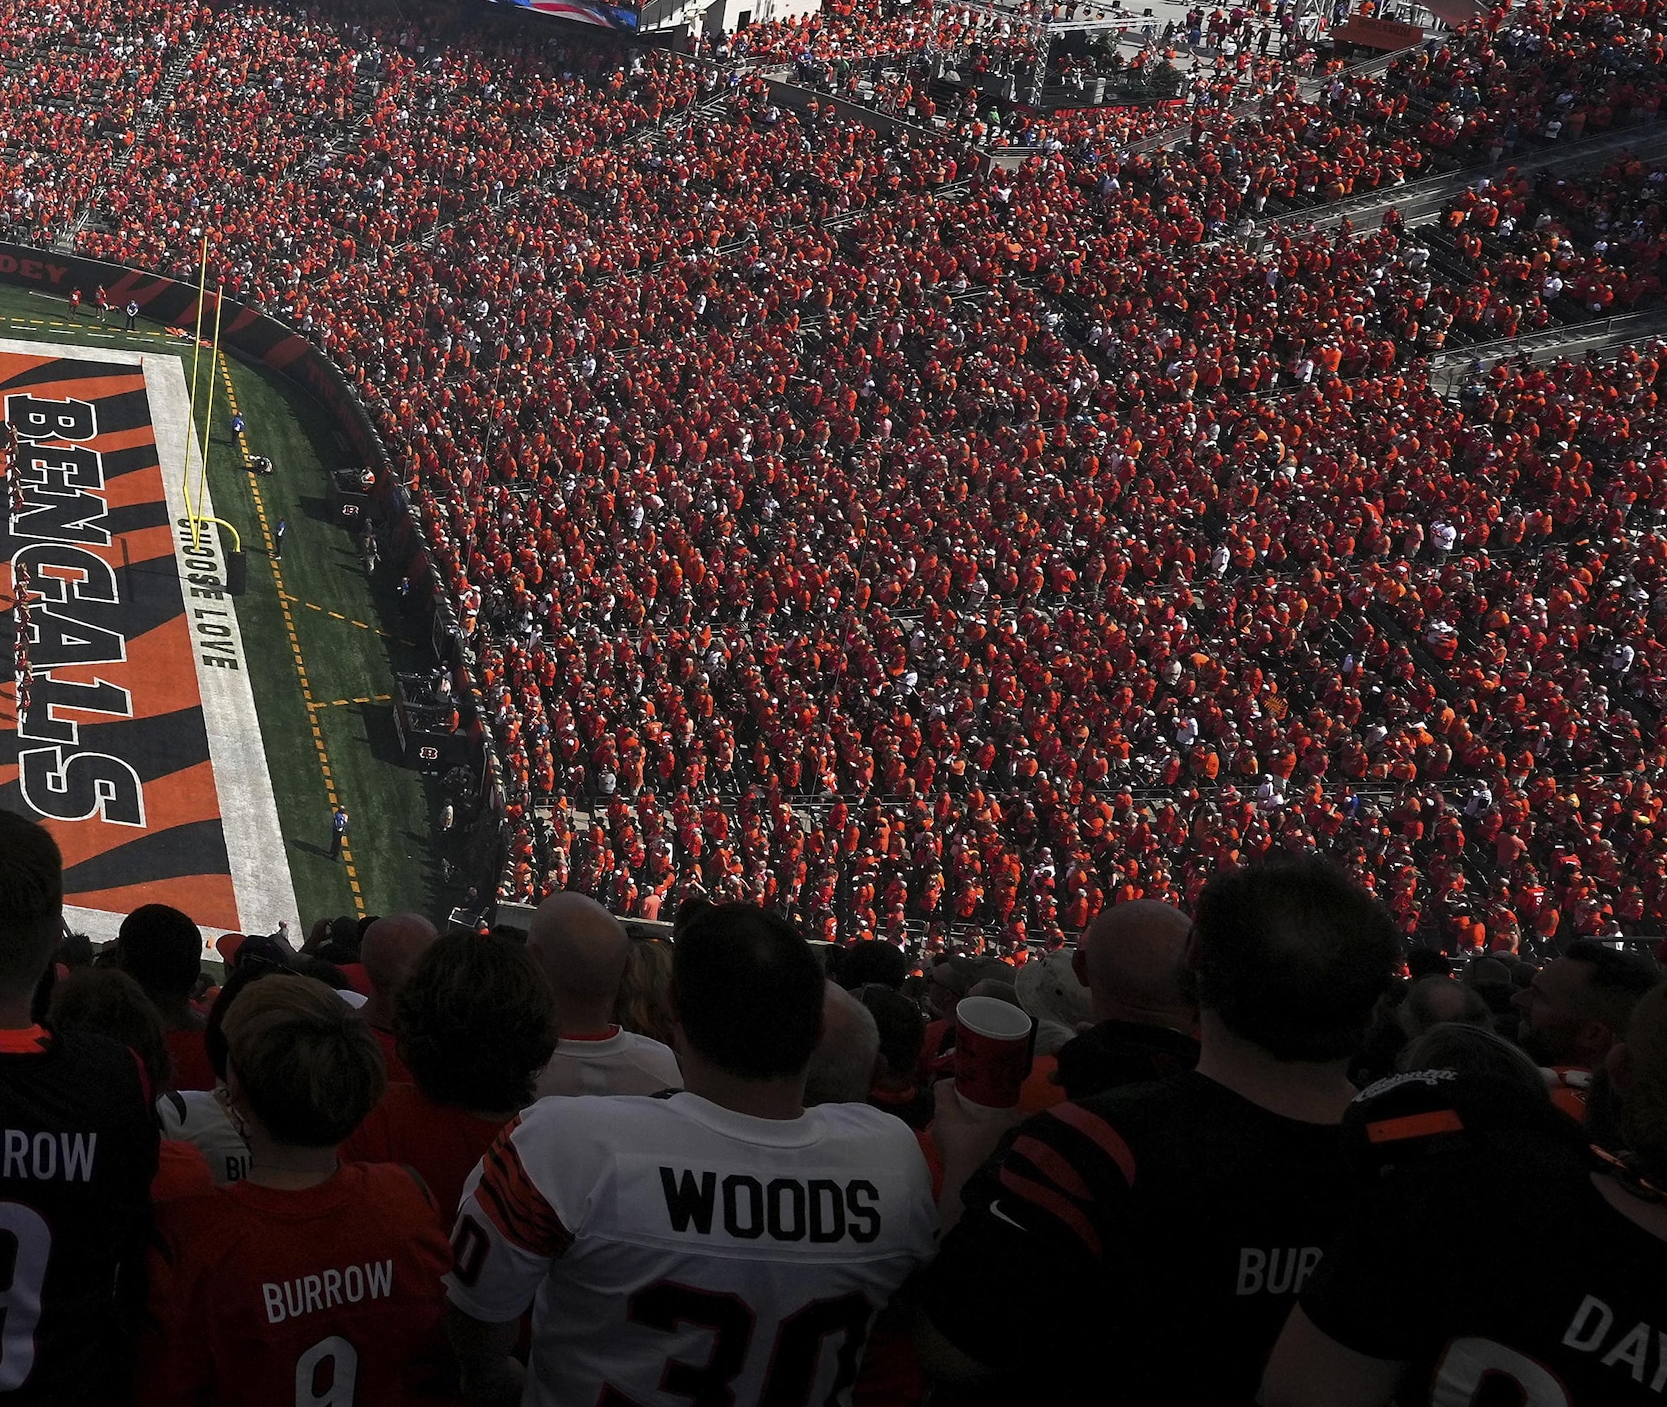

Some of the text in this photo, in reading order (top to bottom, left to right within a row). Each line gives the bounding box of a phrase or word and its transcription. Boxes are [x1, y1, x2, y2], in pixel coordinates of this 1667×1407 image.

[4, 393, 147, 829] BENGALS
[178, 517, 239, 671] CHOOSE LOVE
[658, 1166, 881, 1244] WOODS
[262, 1259, 393, 1324] BURROW
